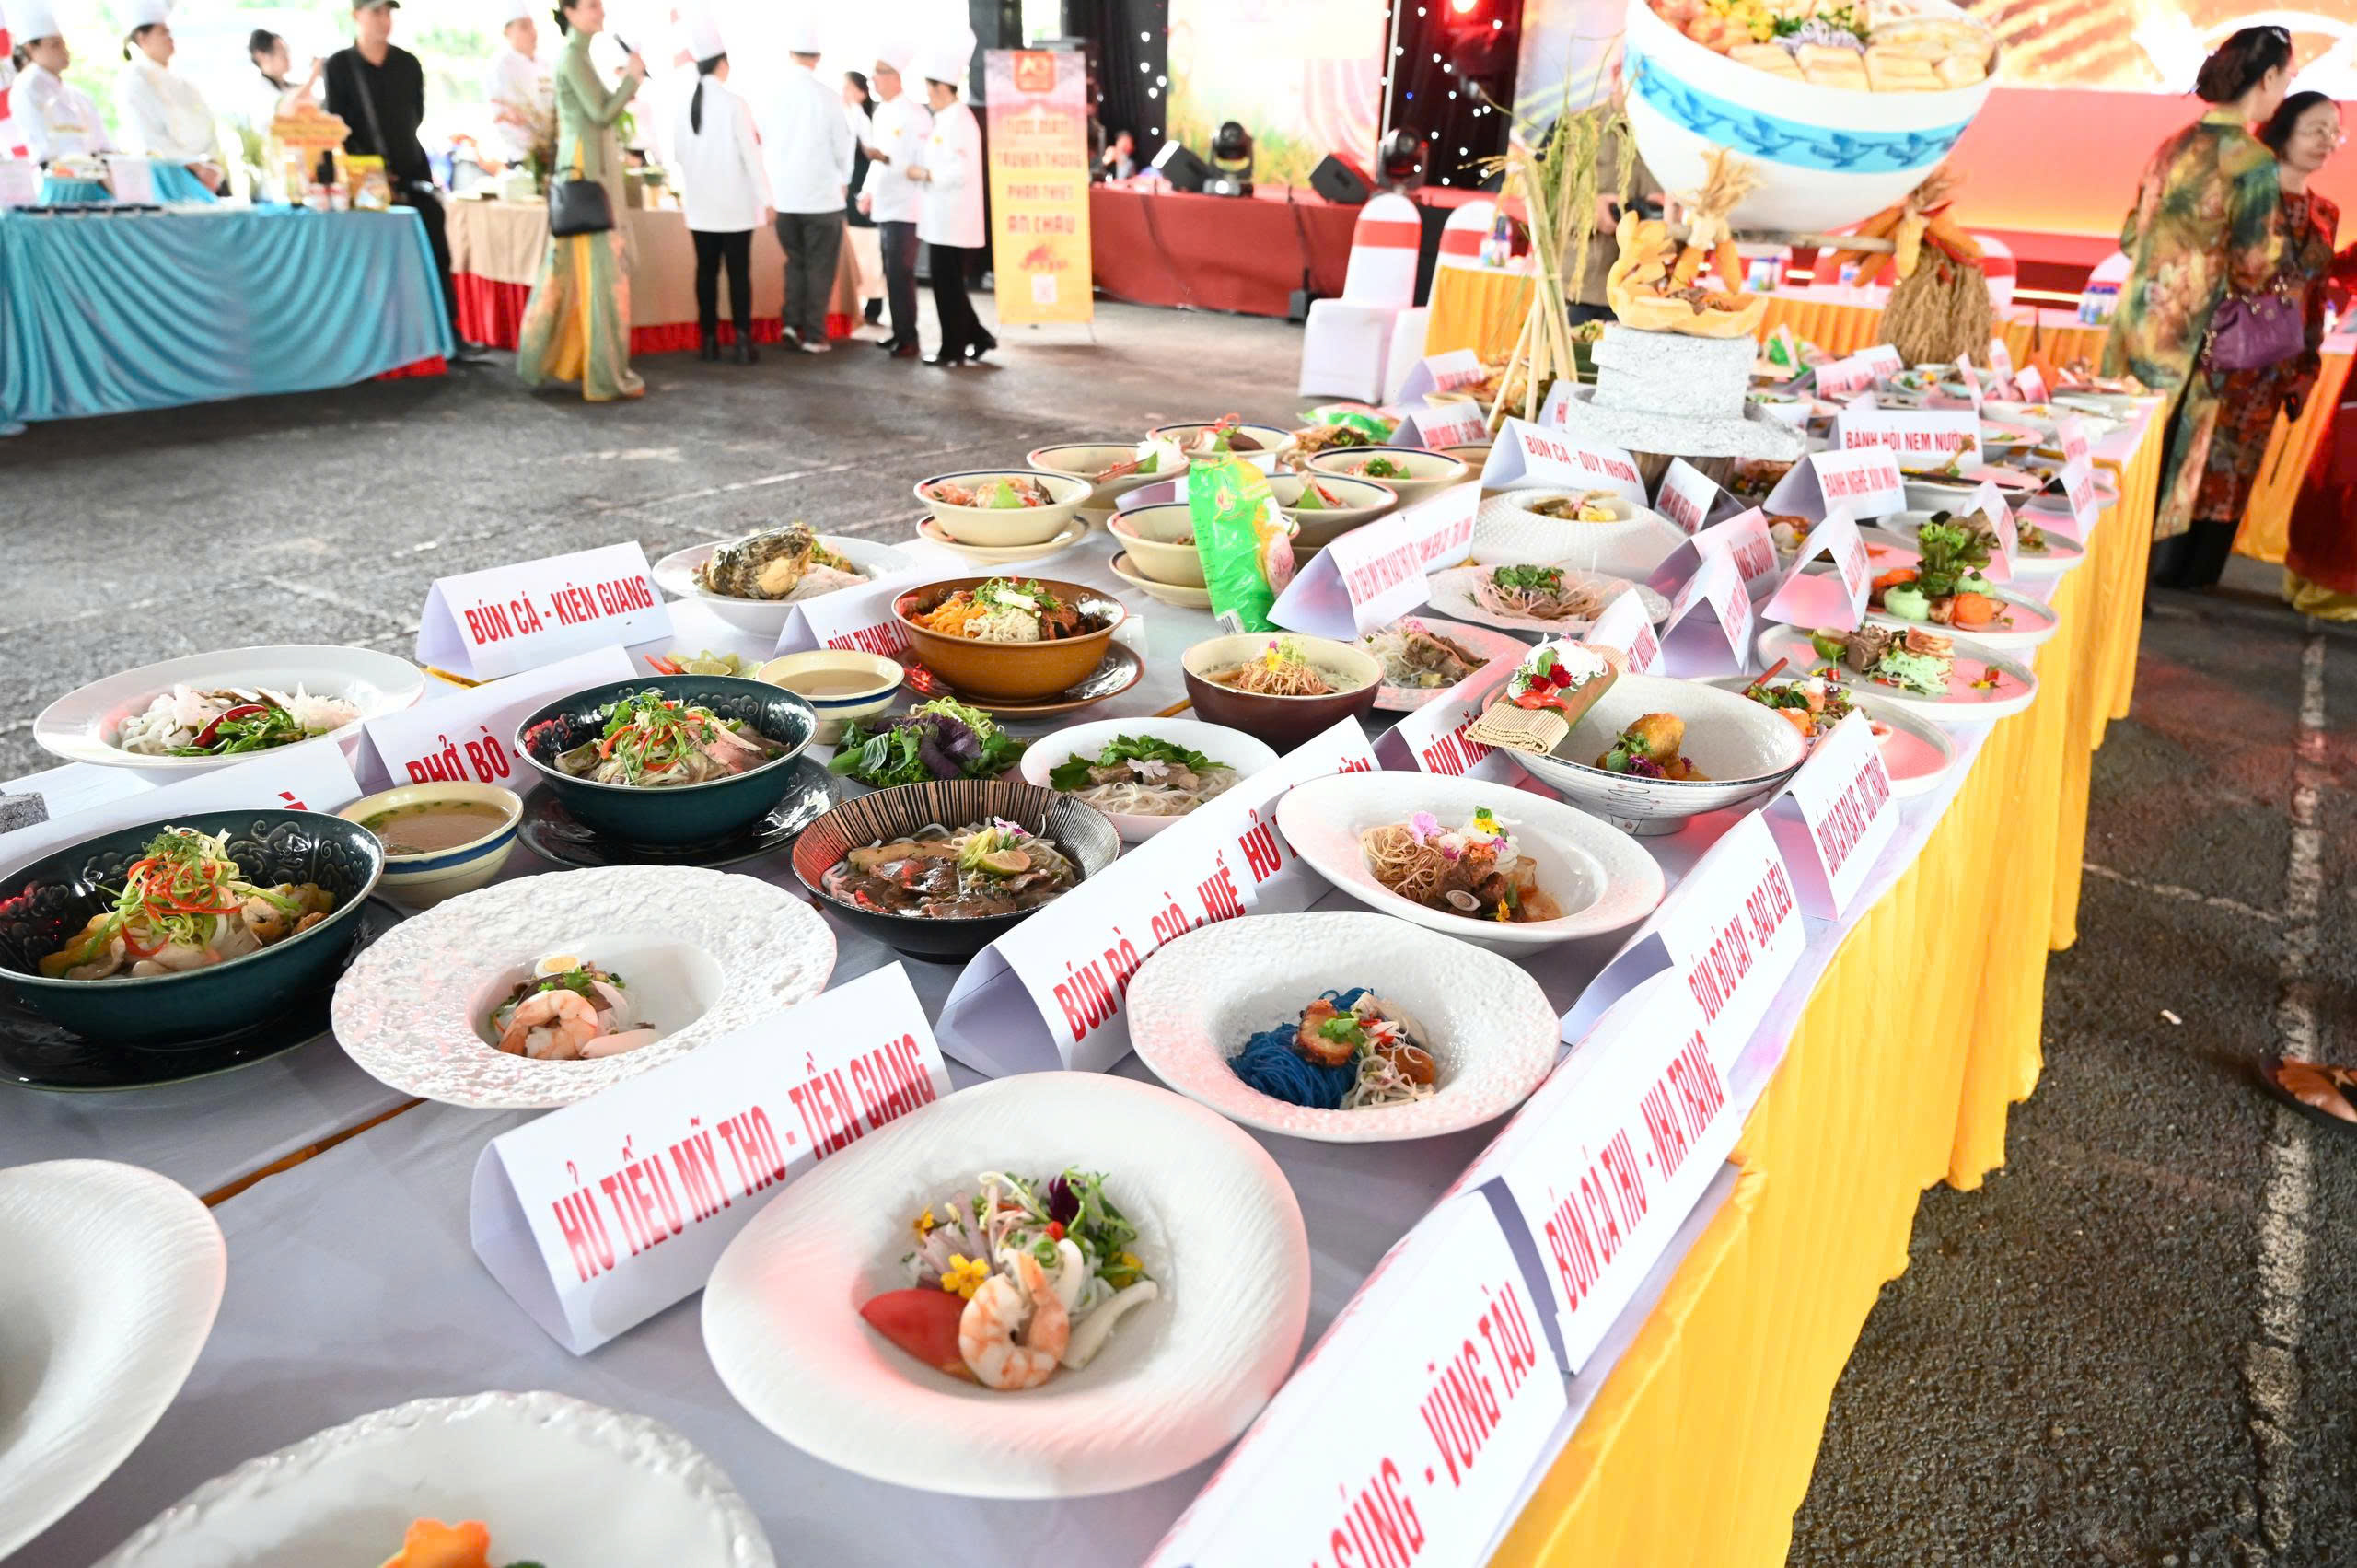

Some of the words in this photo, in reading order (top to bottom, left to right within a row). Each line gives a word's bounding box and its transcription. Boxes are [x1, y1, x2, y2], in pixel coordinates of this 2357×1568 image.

[1524, 434, 1550, 456] BÚN
[1551, 443, 1570, 464] CÁ
[1577, 450, 1604, 472] QUY
[1904, 432, 1931, 451] NEM
[465, 599, 510, 645] BÚN
[515, 590, 544, 633] CÁ
[549, 582, 599, 626] KIÊN
[600, 575, 655, 616] GIANG
[405, 734, 470, 784] PHỞ
[464, 726, 510, 784] BÒ
[1422, 734, 1465, 776] BÚN
[1238, 808, 1281, 883] HỦ
[1816, 810, 1841, 877] BÚN
[1053, 960, 1118, 1043] BÚN
[1103, 926, 1142, 1002] BÒ
[1197, 849, 1246, 923] HUẾ
[1688, 954, 1724, 1026] BÚN
[1709, 926, 1736, 1000] BÒ
[1724, 913, 1753, 980] CAY
[1746, 884, 1775, 952] BẠC
[1763, 858, 1793, 924] LIÊU
[1640, 1078, 1688, 1183] NHA
[1667, 1029, 1724, 1144] TRANG
[552, 1160, 616, 1283] HỦ
[600, 1135, 683, 1257] TIẾU
[669, 1116, 731, 1224] MỸ
[717, 1106, 787, 1197] THO
[787, 1052, 864, 1160] TIỀN
[850, 1033, 936, 1130] GIANG
[1581, 1144, 1622, 1265] CÁ
[1600, 1127, 1647, 1235] THU
[1544, 1186, 1599, 1313] BÚN
[1420, 1339, 1501, 1489] VŨNG
[1478, 1282, 1536, 1400] TÀU
